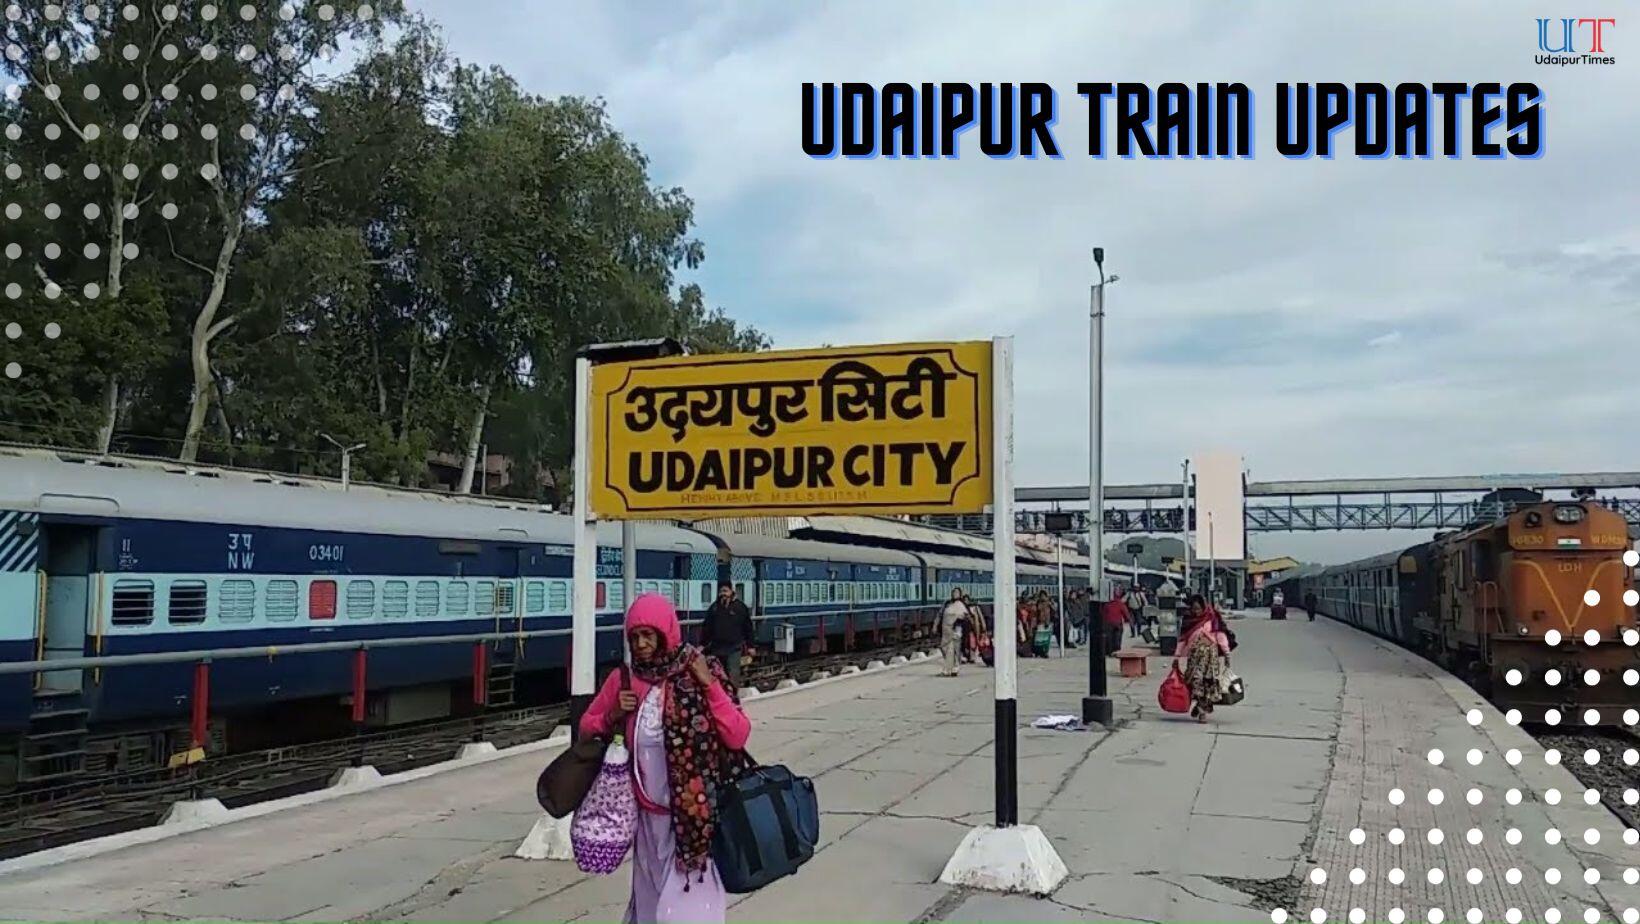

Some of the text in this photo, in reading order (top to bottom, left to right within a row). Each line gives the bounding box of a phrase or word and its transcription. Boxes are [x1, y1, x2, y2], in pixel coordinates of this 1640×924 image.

[624, 357, 958, 443] उदयपुर सिटी
[628, 441, 968, 493] UDAIPUR CITY
[308, 545, 345, 561] 03401
